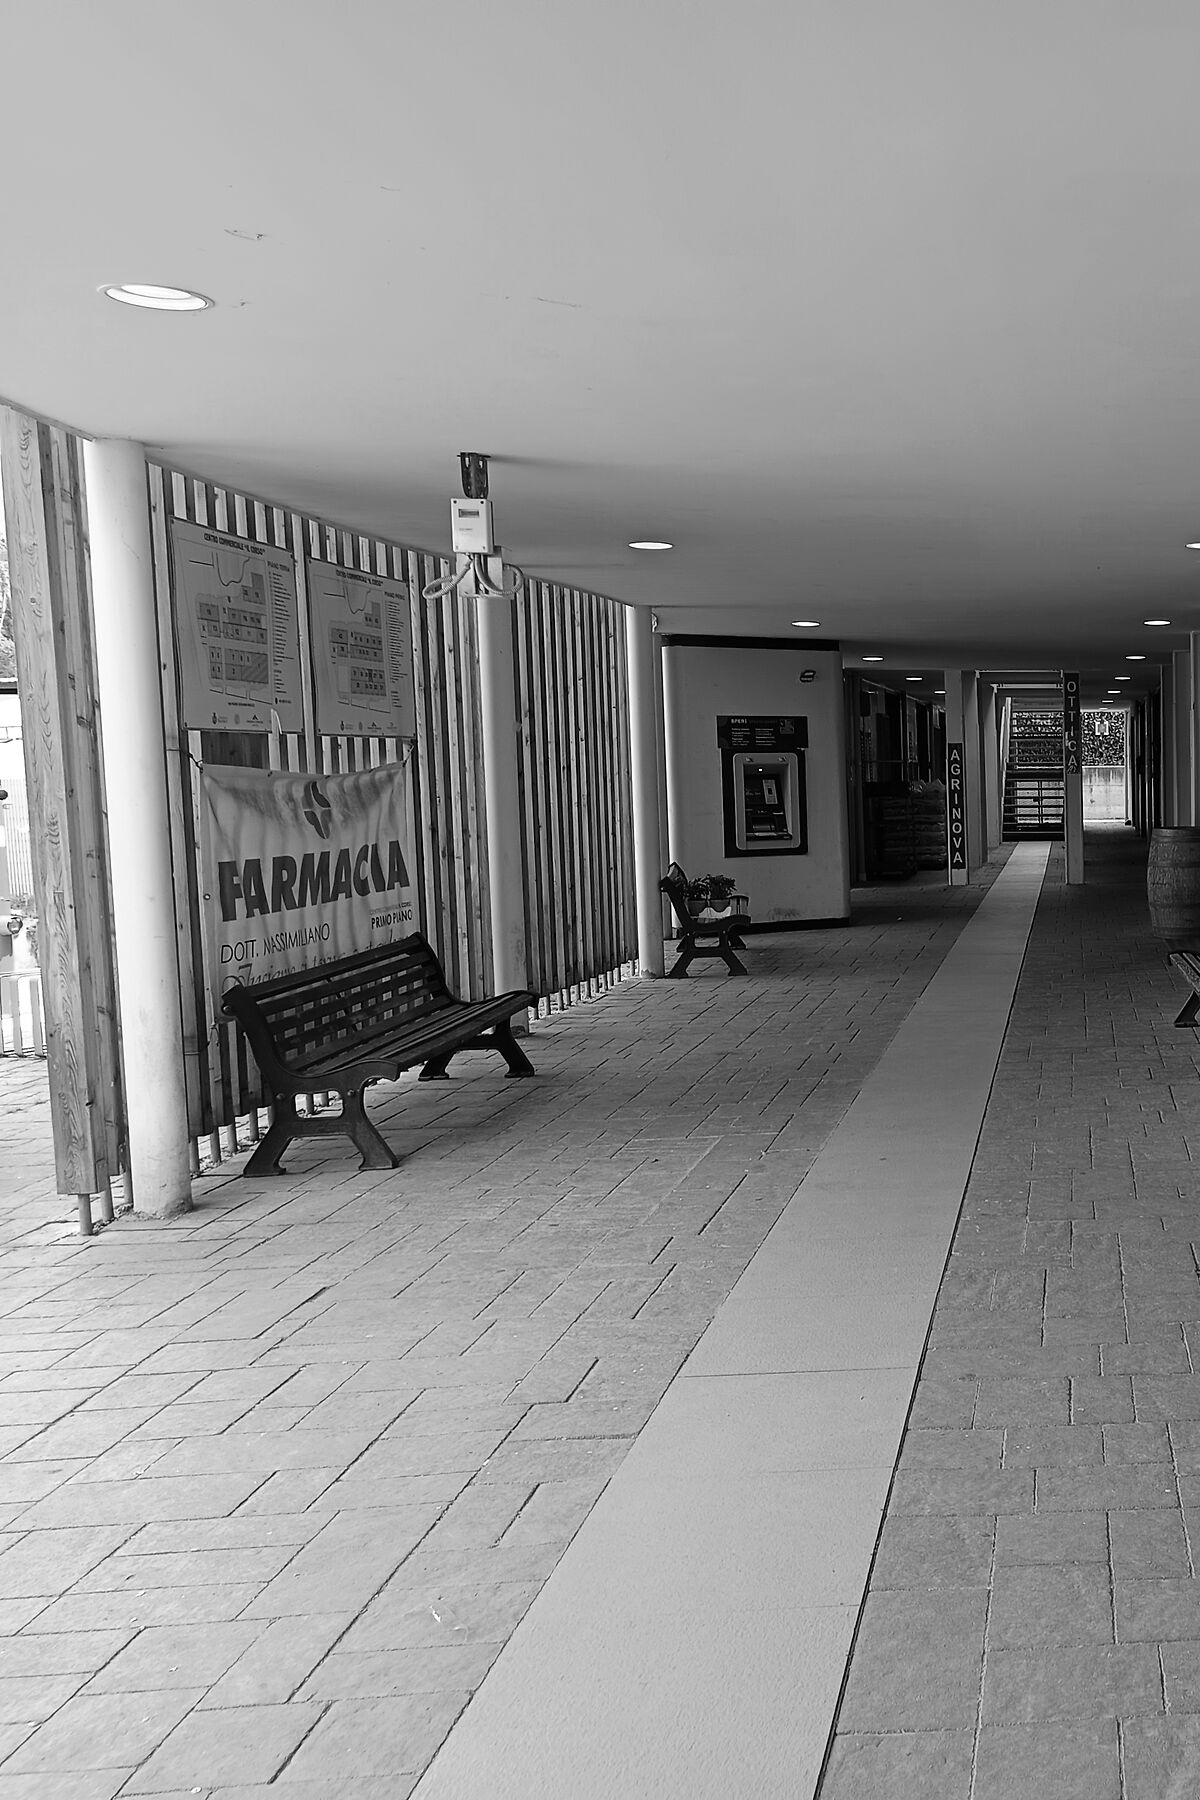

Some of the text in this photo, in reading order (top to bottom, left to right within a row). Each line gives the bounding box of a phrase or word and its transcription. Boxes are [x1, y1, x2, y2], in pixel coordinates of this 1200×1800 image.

[1067, 681, 1077, 766] OTTICA
[951, 750, 963, 863] AGRINOVA
[218, 840, 410, 922] FARMACIA
[220, 940, 259, 964] DOTT.
